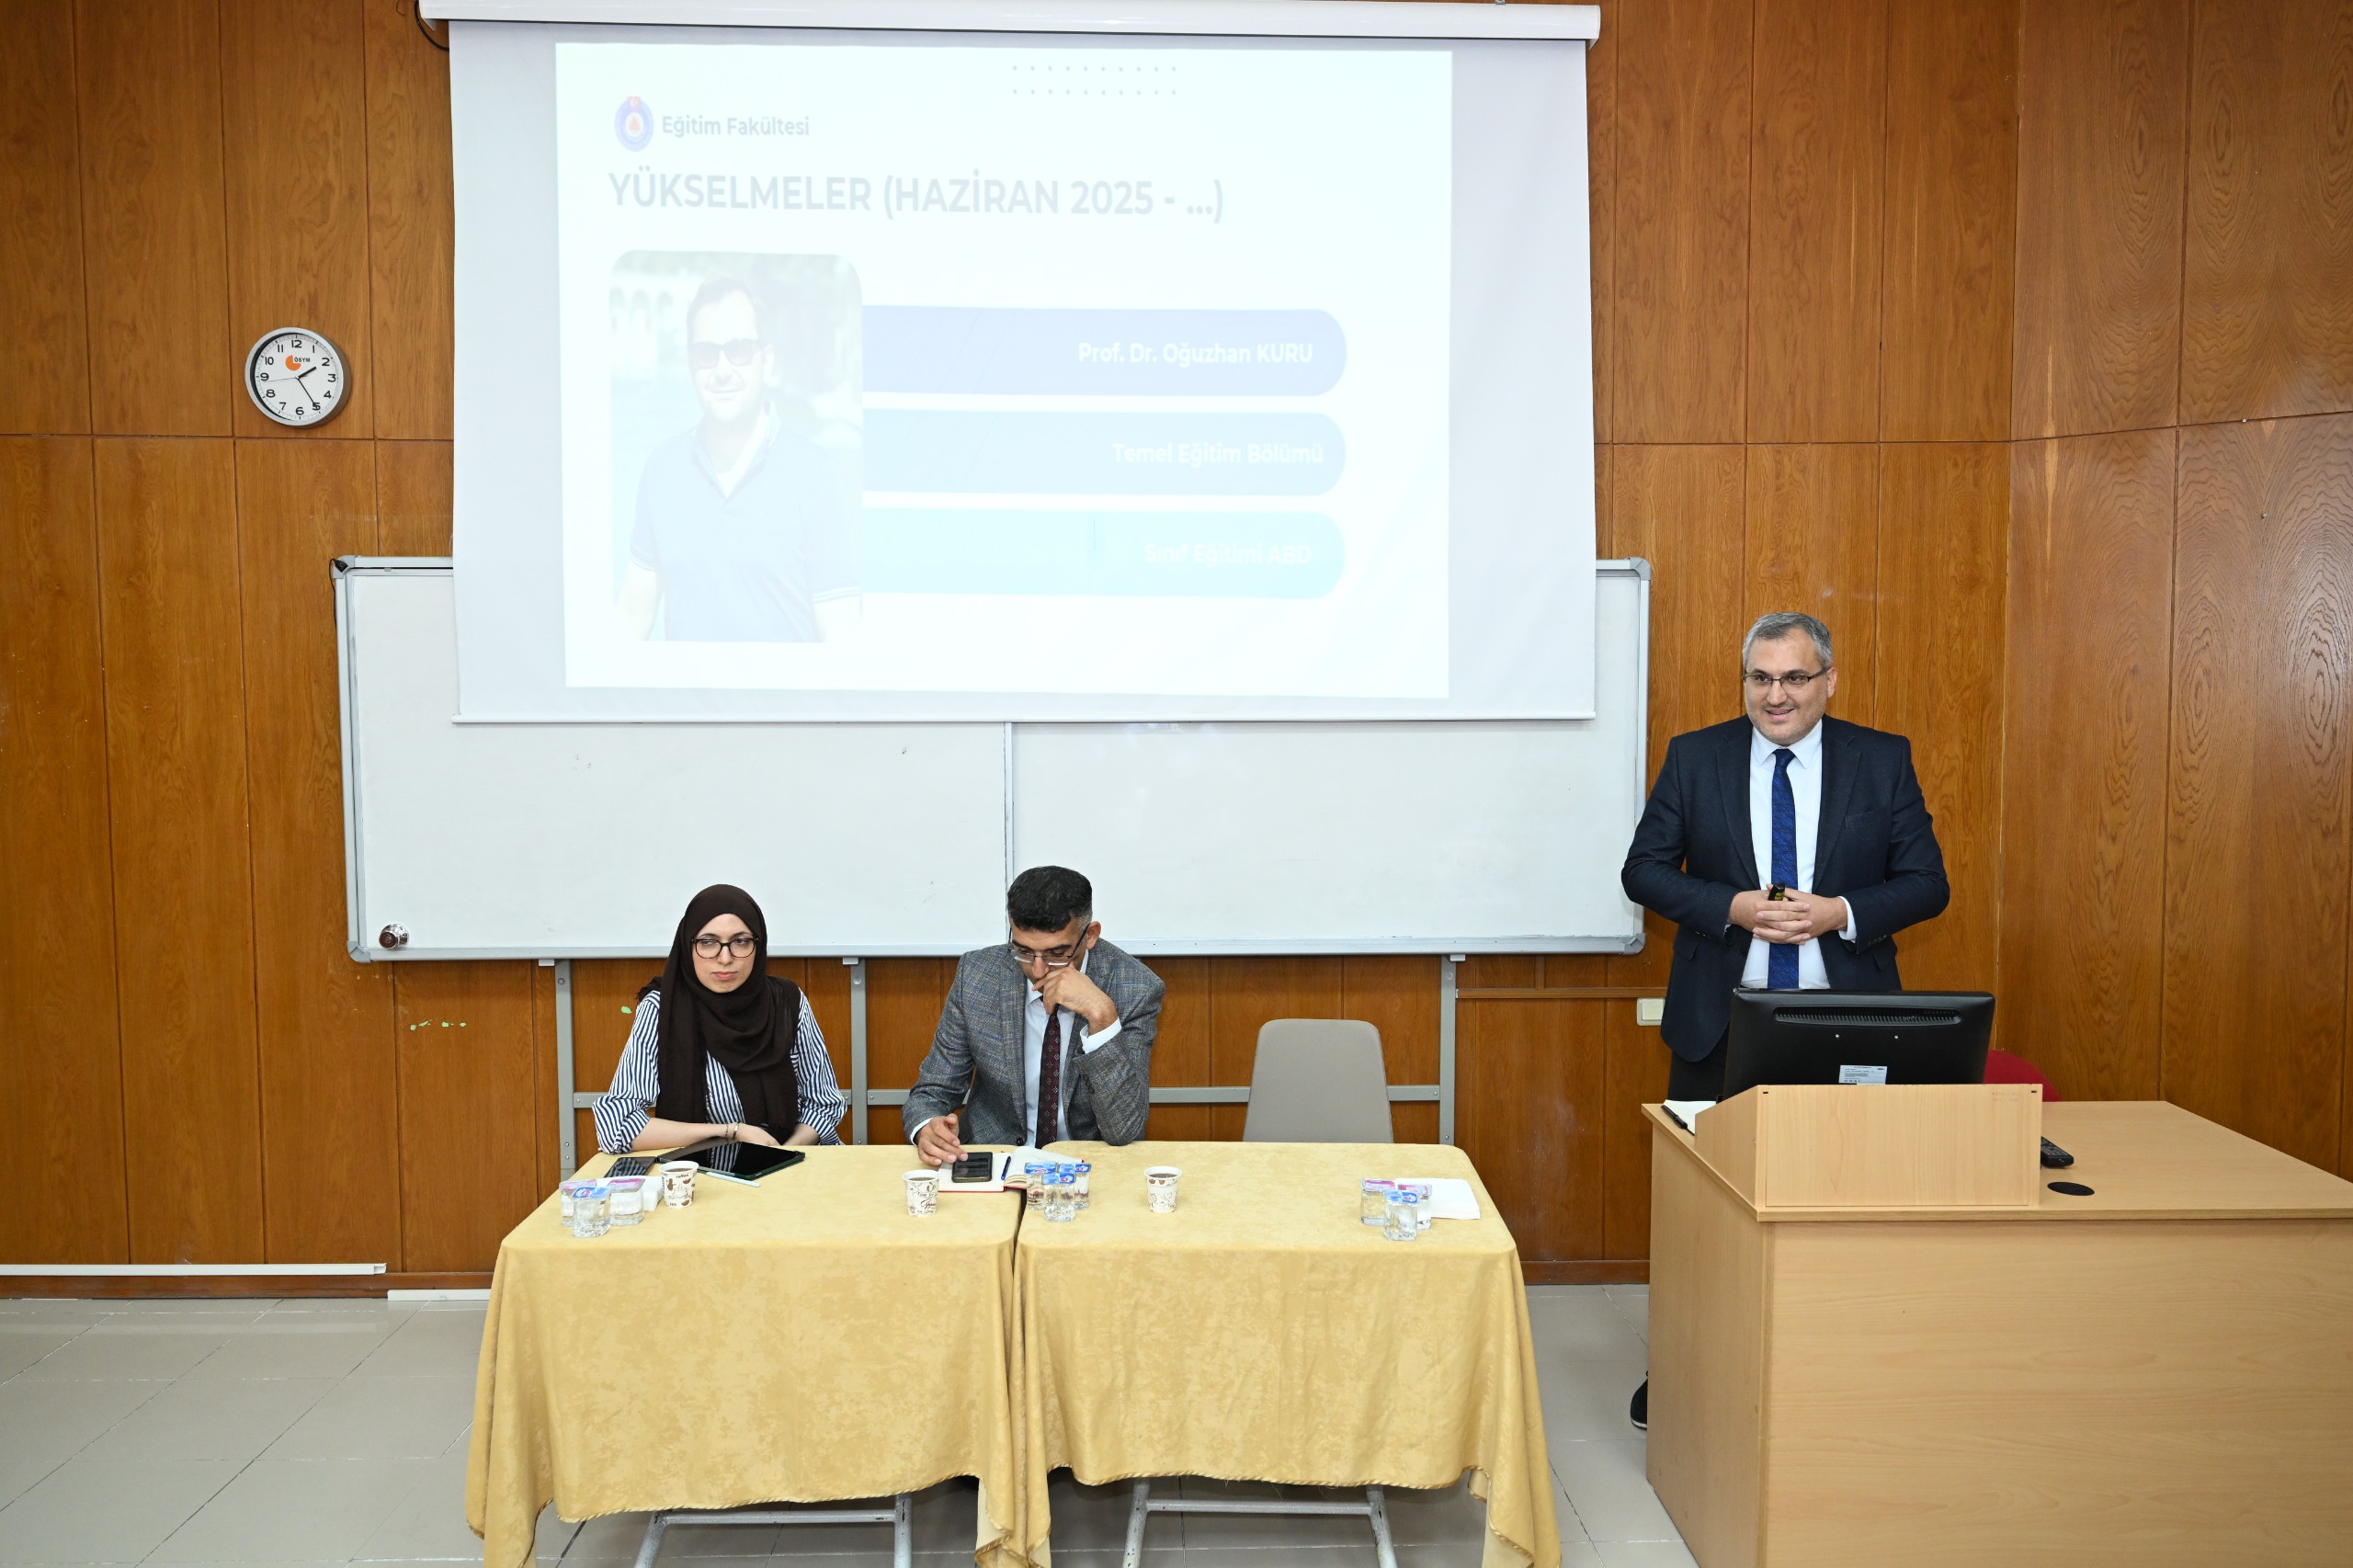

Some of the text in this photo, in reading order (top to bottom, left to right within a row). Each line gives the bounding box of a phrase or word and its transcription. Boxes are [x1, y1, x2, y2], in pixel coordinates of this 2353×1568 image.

[662, 115, 722, 139] Eğitim
[726, 116, 810, 137] Fakültesi
[608, 165, 871, 211] YÜKSELMELER
[883, 169, 1059, 220] (HAZİRAN
[1071, 181, 1153, 215] 2025
[291, 339, 302, 348] 12
[277, 344, 284, 353] 11
[1078, 341, 1313, 369] Prof. Dr. Oğuzhan KURU
[265, 357, 274, 366] 10
[322, 358, 330, 367] 2
[260, 372, 269, 381] 9
[327, 373, 336, 382] 3
[266, 389, 276, 398] 8
[324, 390, 332, 399] 4
[279, 402, 287, 411] 7
[295, 406, 304, 415] 6
[1112, 440, 1324, 468] Temel Eğitim Bölümü
[1267, 544, 1313, 565] ABD
